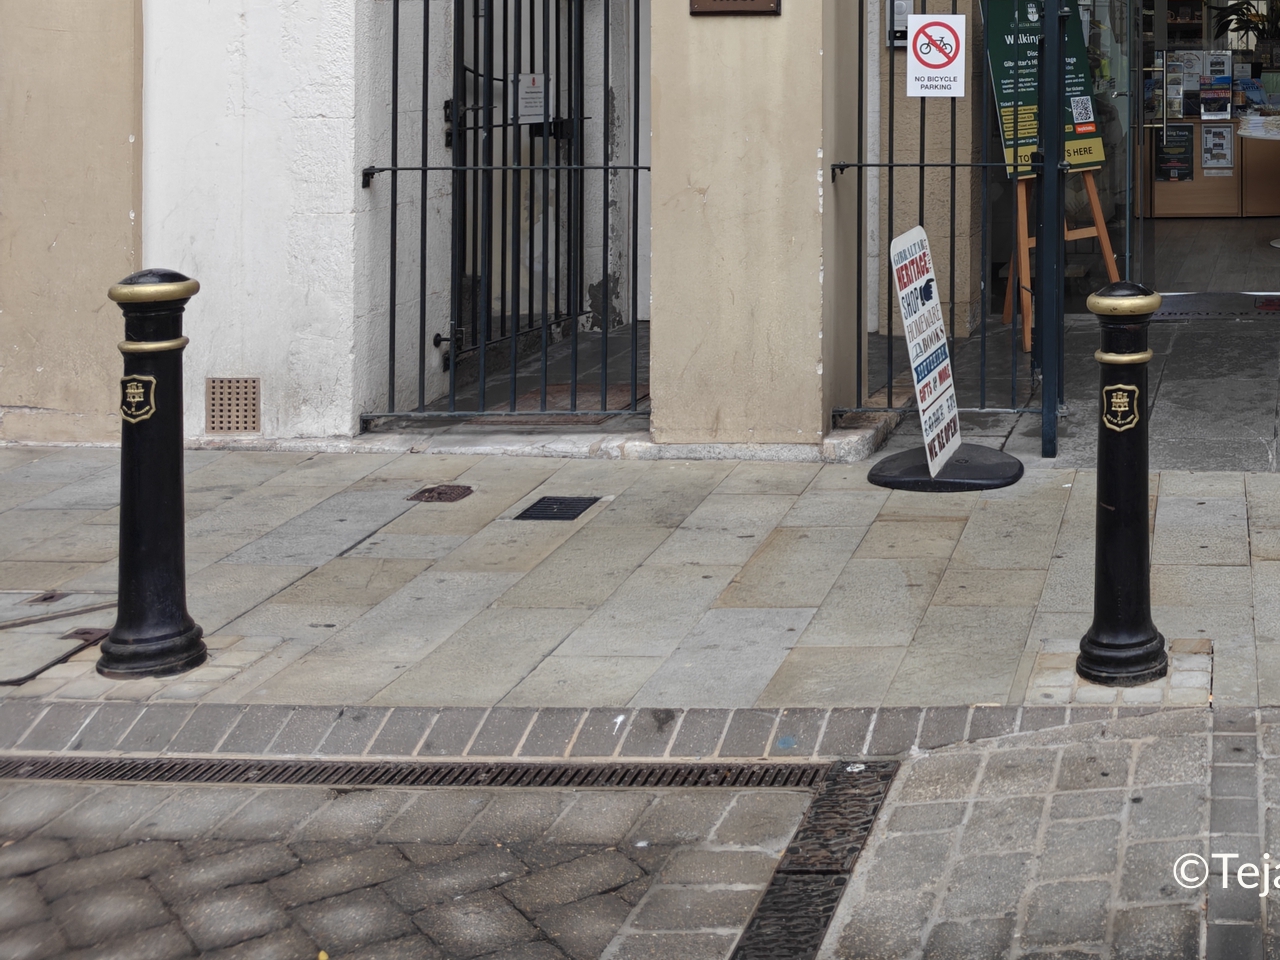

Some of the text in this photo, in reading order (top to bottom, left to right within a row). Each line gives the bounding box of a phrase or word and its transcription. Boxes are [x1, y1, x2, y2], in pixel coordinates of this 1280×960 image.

[1073, 146, 1093, 156] HERE
[893, 239, 926, 267] GIBRALTAR
[895, 251, 930, 292] HERITAGE
[901, 287, 920, 320] SHOP
[906, 303, 941, 343] HOMEWARE
[922, 324, 945, 354] BOOKS
[919, 380, 932, 404] GIFTS
[937, 363, 951, 386] MORE
